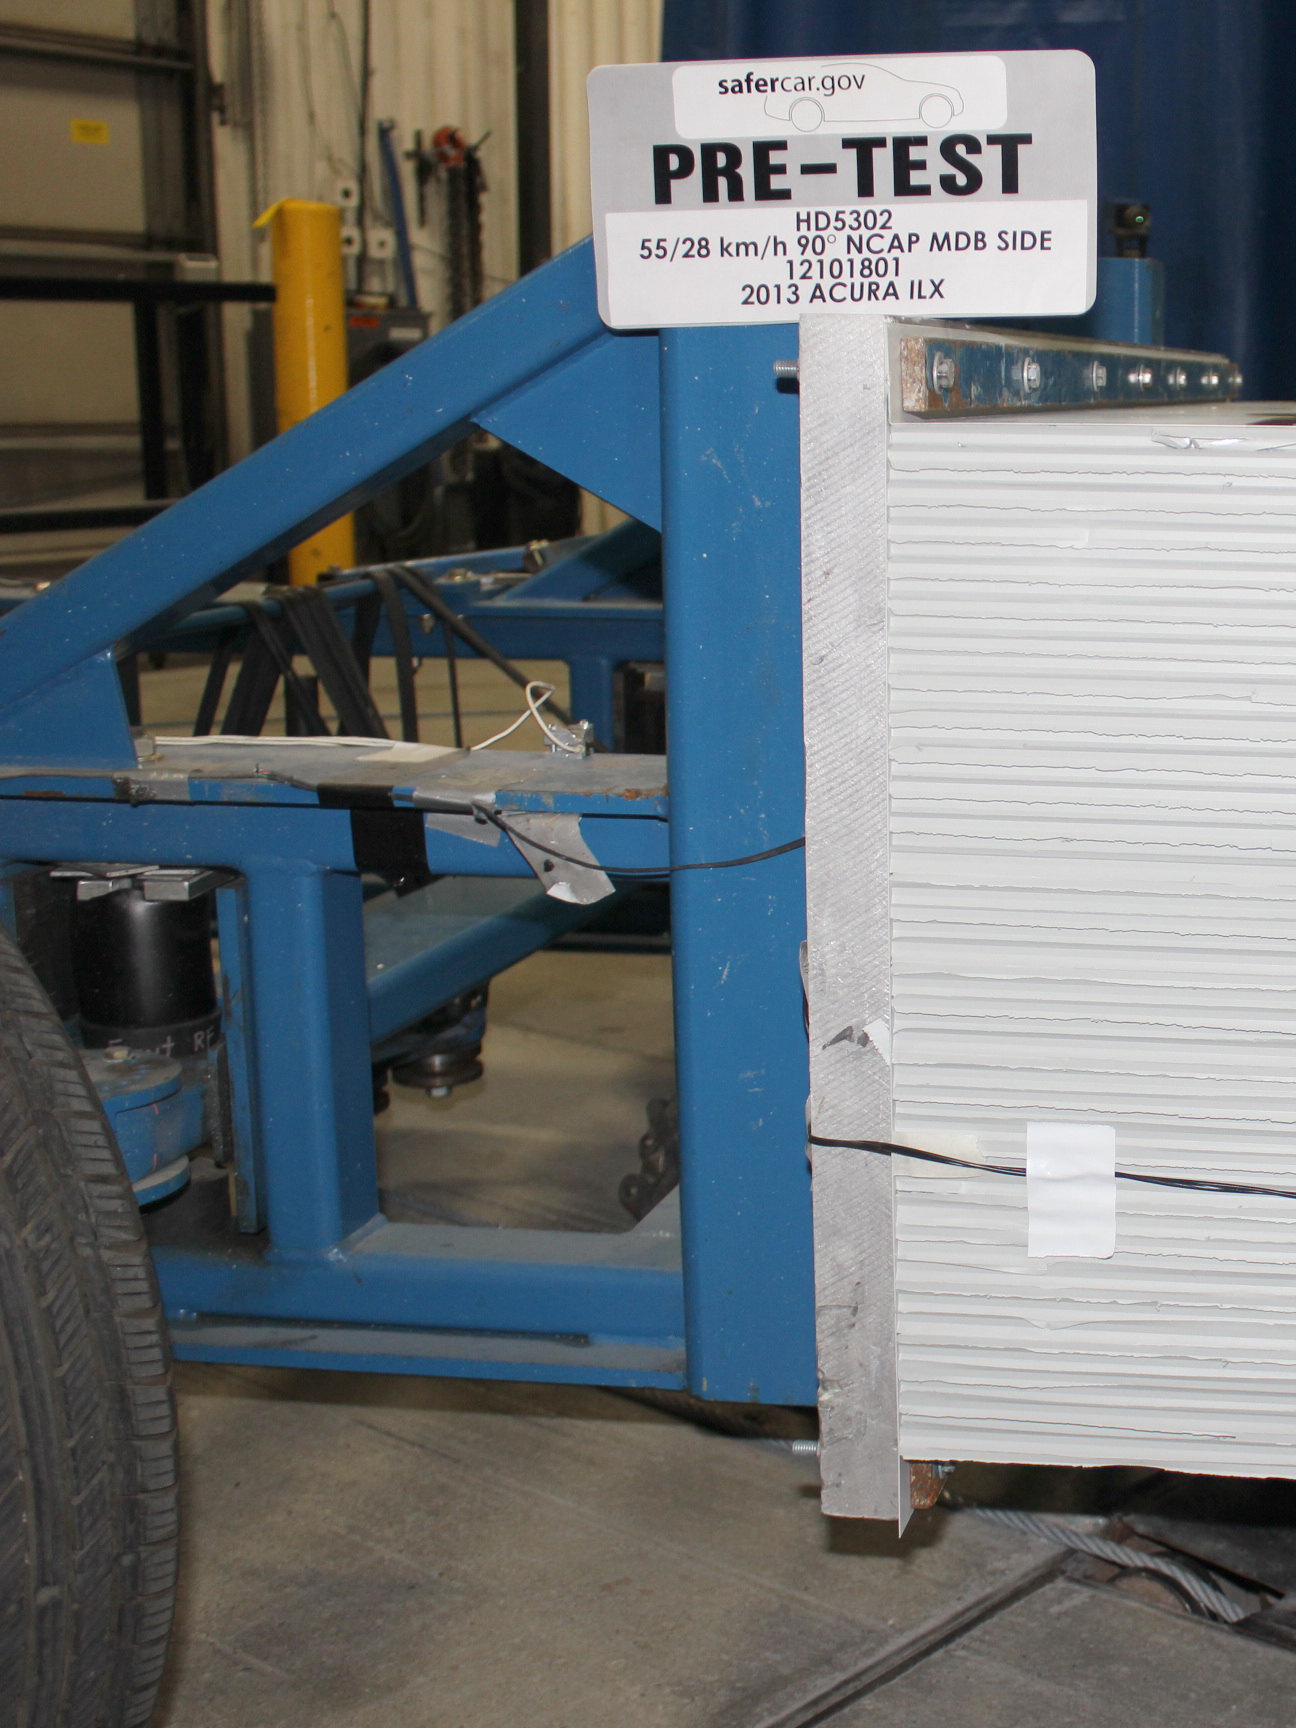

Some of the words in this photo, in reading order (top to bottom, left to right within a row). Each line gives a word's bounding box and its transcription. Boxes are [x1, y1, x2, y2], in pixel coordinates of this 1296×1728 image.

[718, 72, 866, 97] safercar.gov
[652, 133, 1033, 205] PRE-TEST
[795, 209, 893, 232] HD5302
[639, 237, 711, 263] 55/28
[719, 235, 788, 261] km/h
[796, 233, 837, 256] 90°
[846, 232, 921, 255] NCAP
[929, 230, 988, 253] MDB
[996, 229, 1052, 252] SIDE
[786, 256, 900, 281] 12101801
[740, 282, 801, 306] 2013
[808, 280, 900, 304] ACURA
[909, 278, 945, 300] ILX
